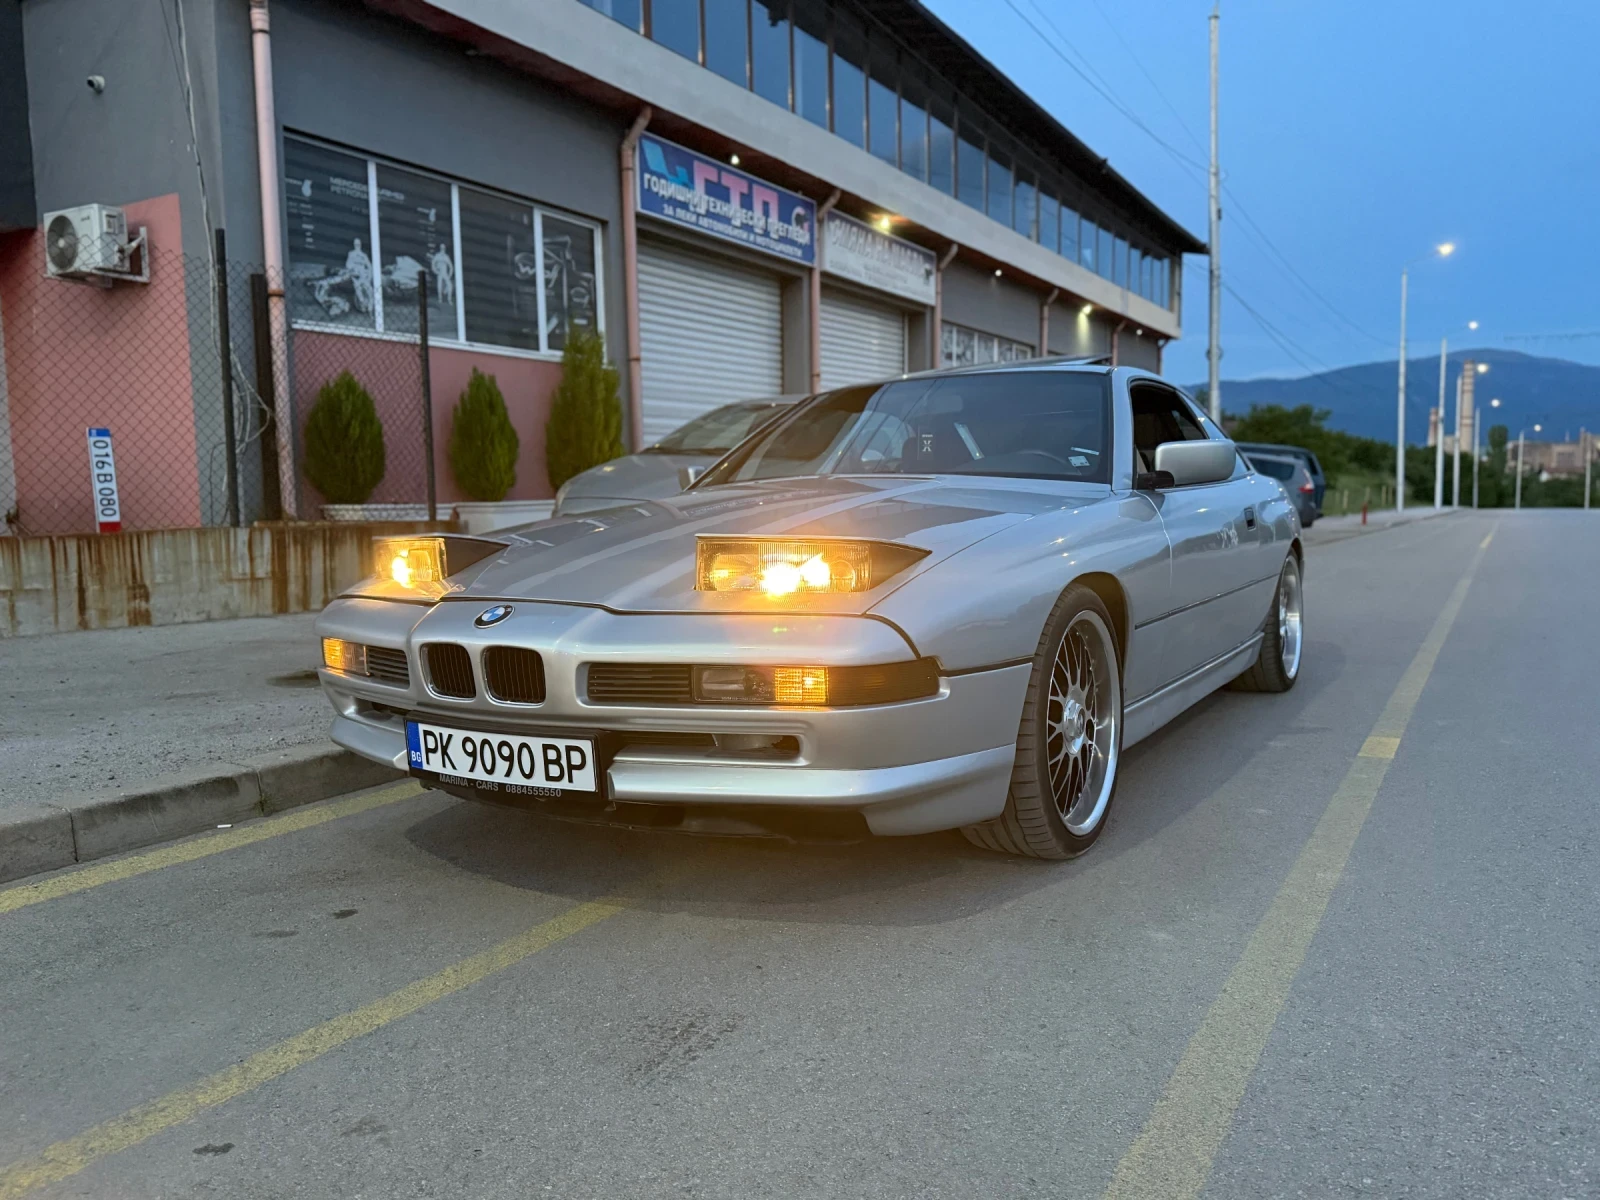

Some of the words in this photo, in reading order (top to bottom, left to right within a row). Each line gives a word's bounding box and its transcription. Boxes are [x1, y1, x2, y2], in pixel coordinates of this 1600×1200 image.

[330, 185, 370, 200] PETRONA
[411, 750, 422, 762] BG
[423, 729, 457, 770] PK
[461, 736, 535, 780] 9090
[542, 743, 587, 784] BP
[439, 774, 469, 787] MARINA
[476, 780, 499, 791] CARS
[505, 784, 562, 798] 0884555550
